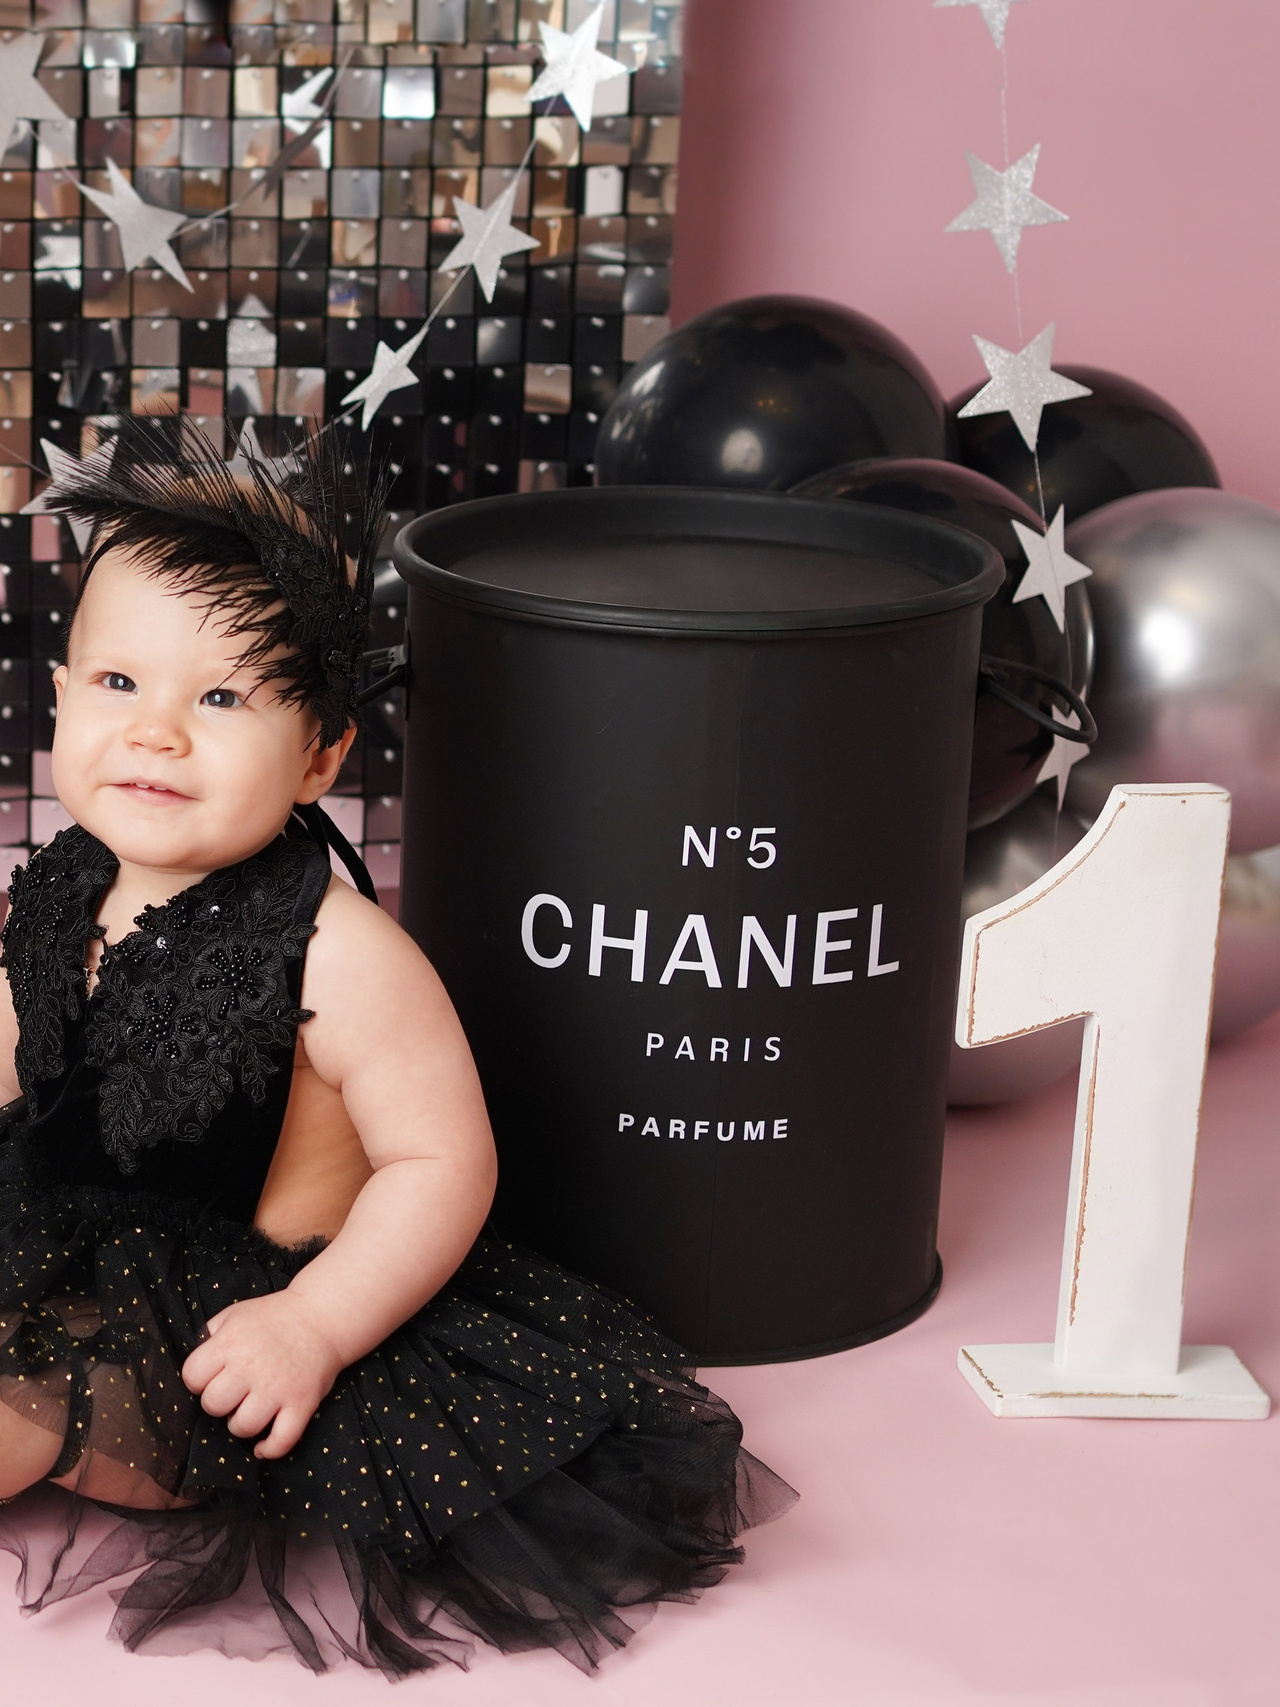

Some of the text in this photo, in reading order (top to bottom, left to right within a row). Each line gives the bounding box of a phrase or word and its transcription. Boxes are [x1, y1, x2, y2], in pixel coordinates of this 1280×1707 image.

[521, 893, 900, 989] CHANEL
[645, 1032, 782, 1063] PARIS
[618, 1113, 789, 1142] PARFUME
